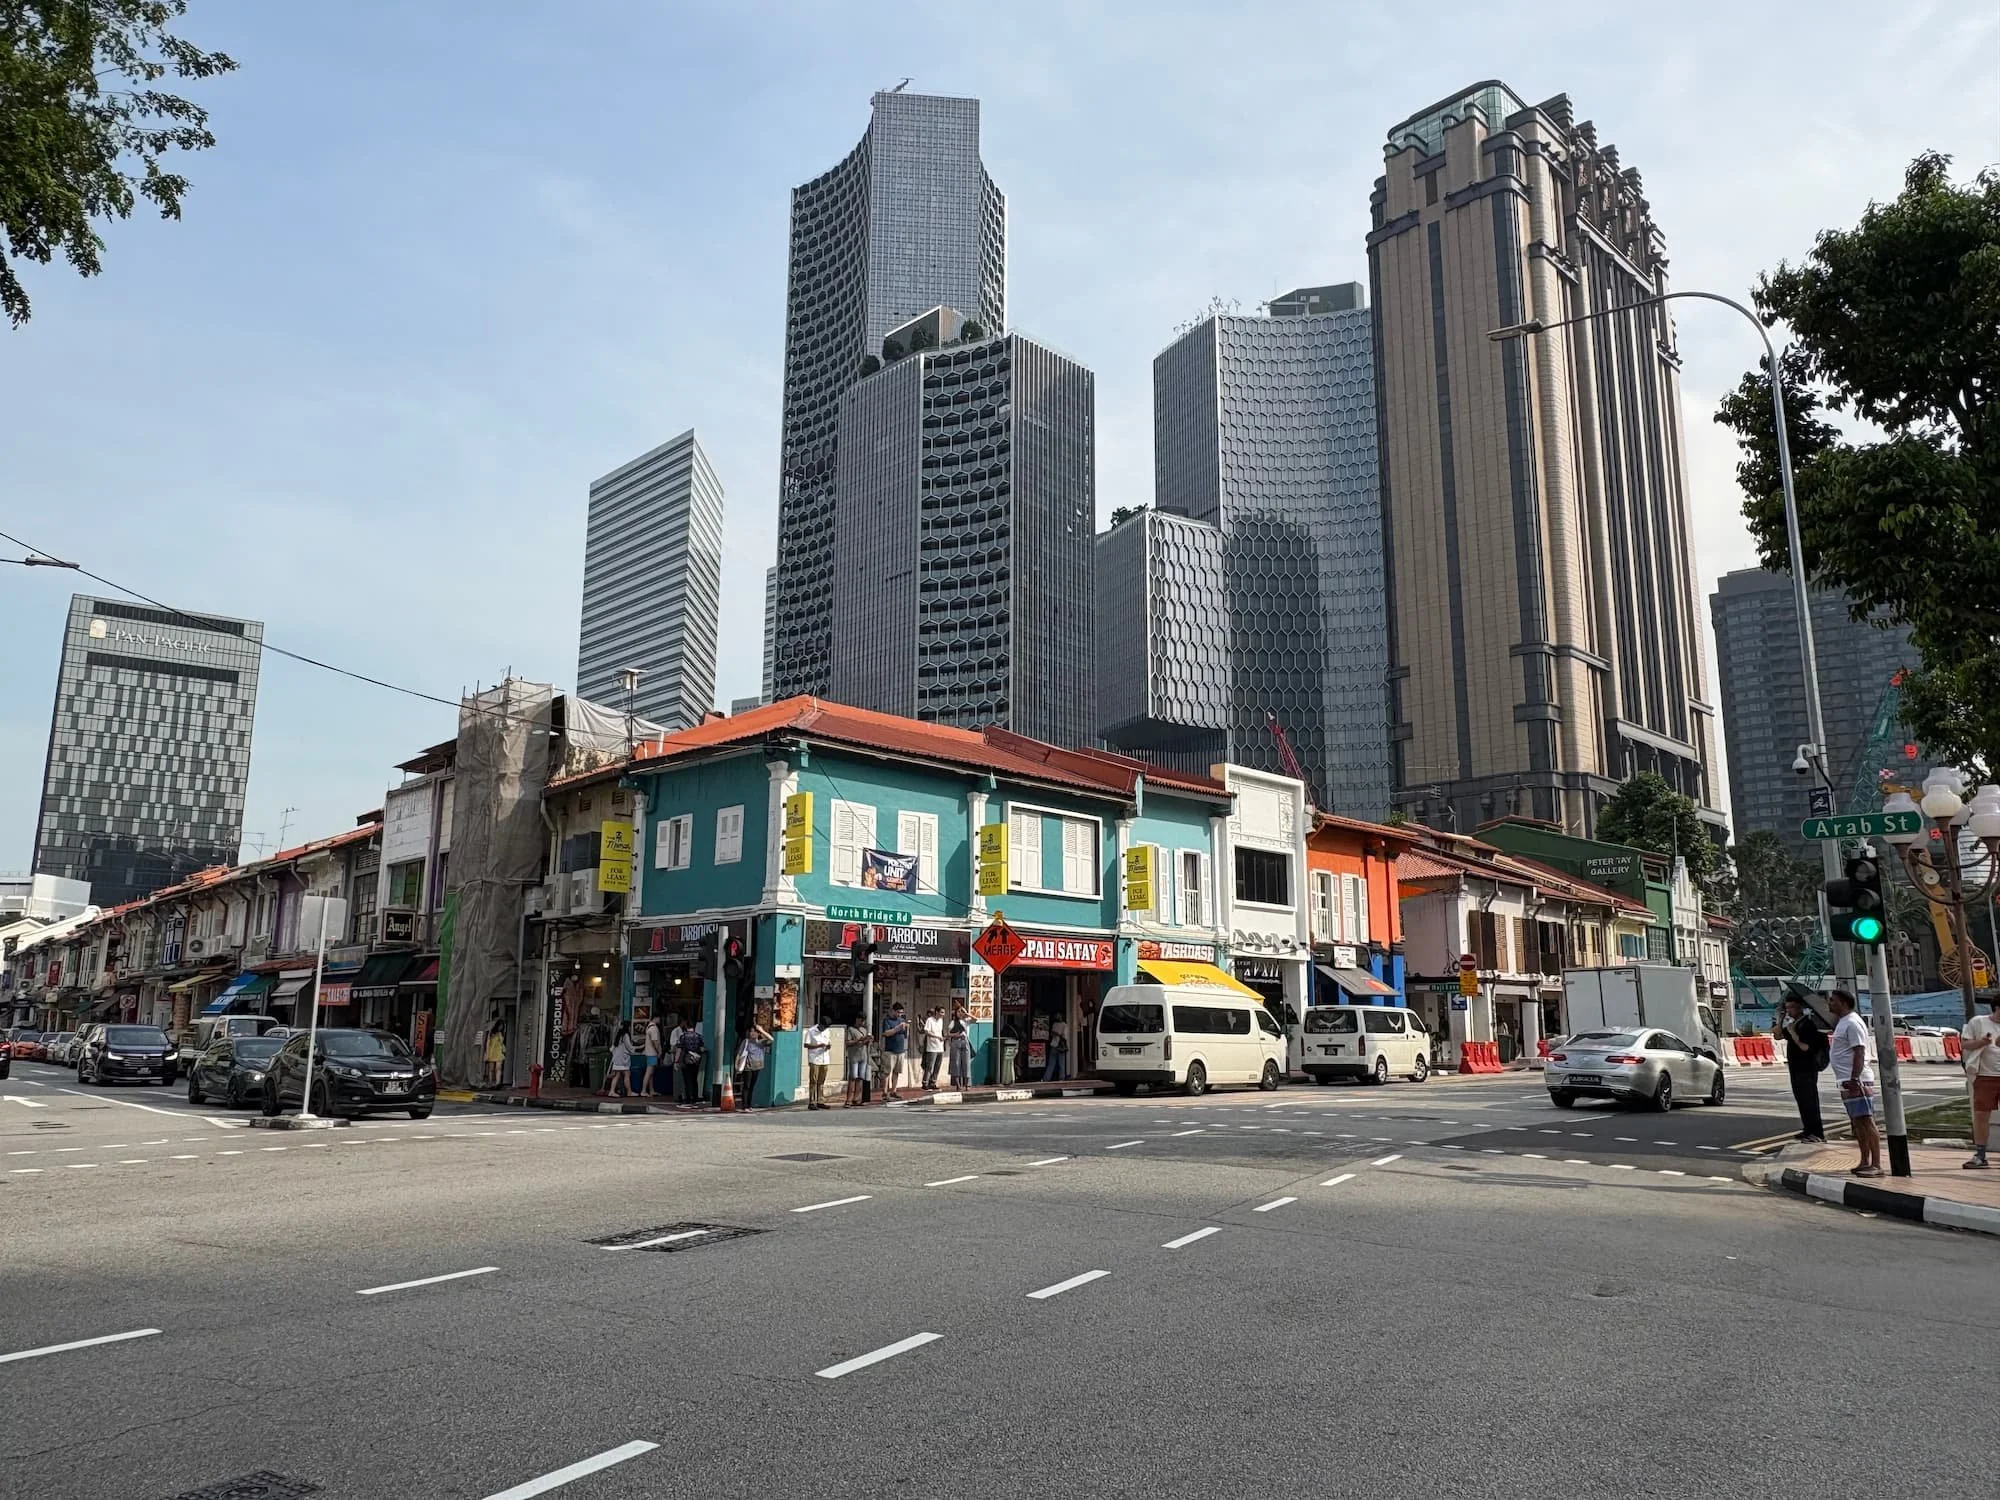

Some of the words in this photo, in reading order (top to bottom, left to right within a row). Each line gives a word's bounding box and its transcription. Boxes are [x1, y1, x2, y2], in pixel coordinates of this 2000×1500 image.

[115, 628, 147, 645] PAN
[155, 634, 212, 654] PACIFIC
[1815, 816, 1872, 838] Arab
[1883, 815, 1909, 833] St
[1586, 858, 1614, 867] PETER
[1615, 856, 1632, 864] TAY
[1590, 866, 1630, 876] GALLERY
[831, 906, 860, 918] North
[863, 908, 894, 923] Bridge
[896, 911, 908, 923] Rd
[387, 916, 412, 937] Angel
[886, 926, 938, 945] TARBOUSH
[983, 943, 1016, 957] MERGE
[1057, 942, 1098, 961] SATAY
[549, 998, 563, 1059] snackshop
